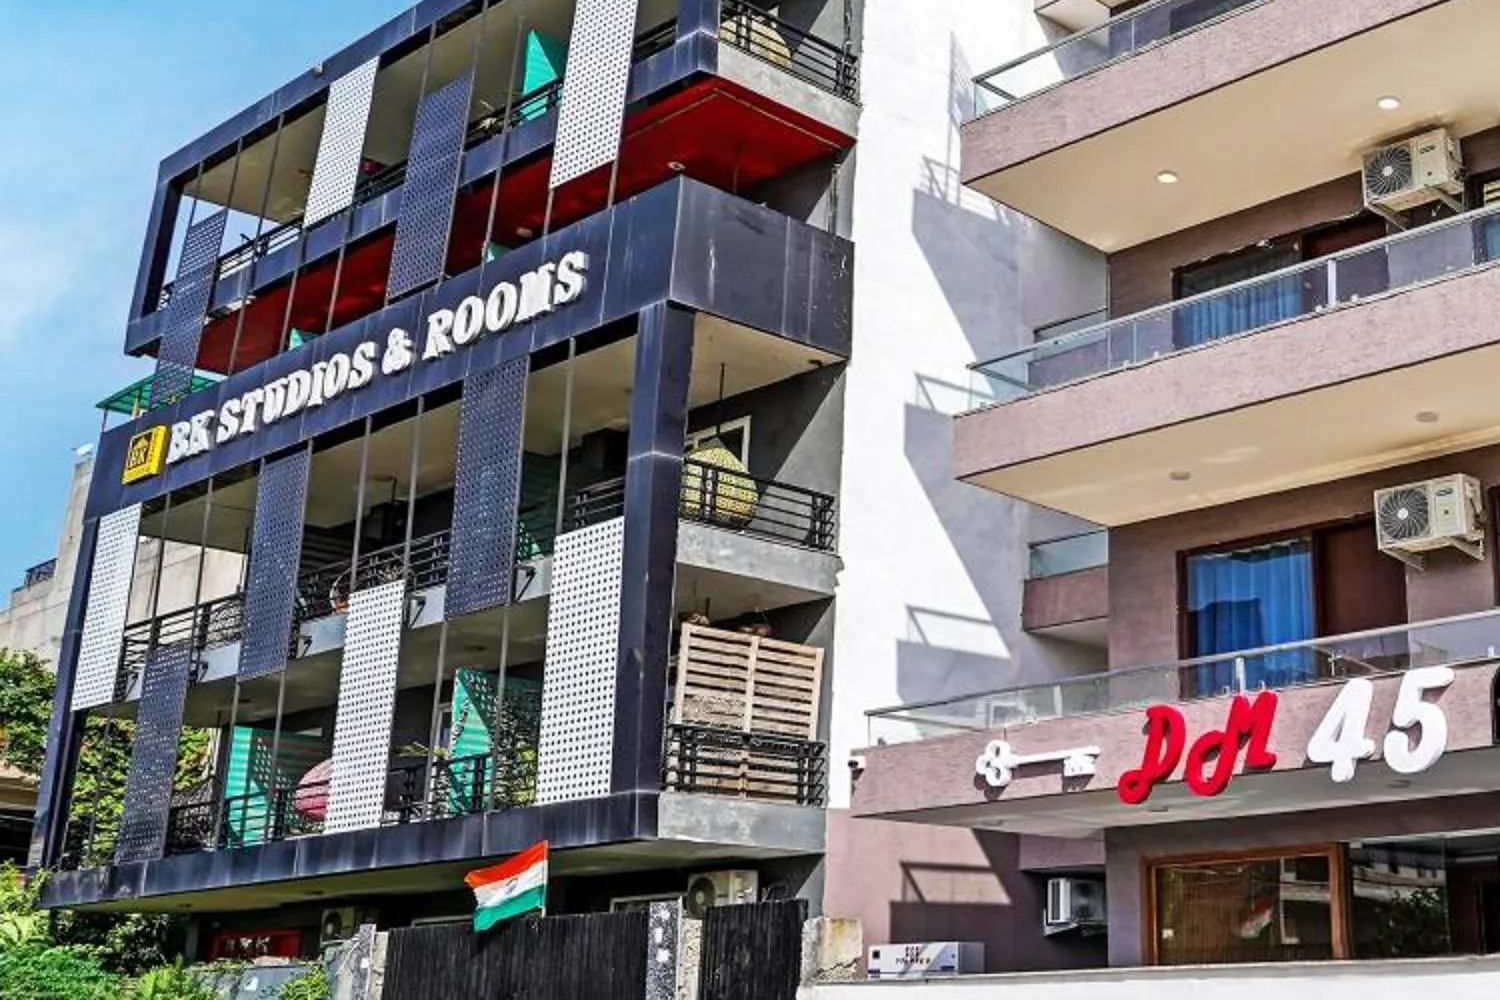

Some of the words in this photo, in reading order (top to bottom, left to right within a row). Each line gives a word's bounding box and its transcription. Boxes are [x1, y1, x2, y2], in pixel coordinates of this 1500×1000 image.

[166, 419, 217, 465] BK
[216, 341, 376, 443] STUDIOS
[381, 327, 415, 375] &
[421, 249, 590, 361] ROOMS
[1306, 666, 1455, 783] 45
